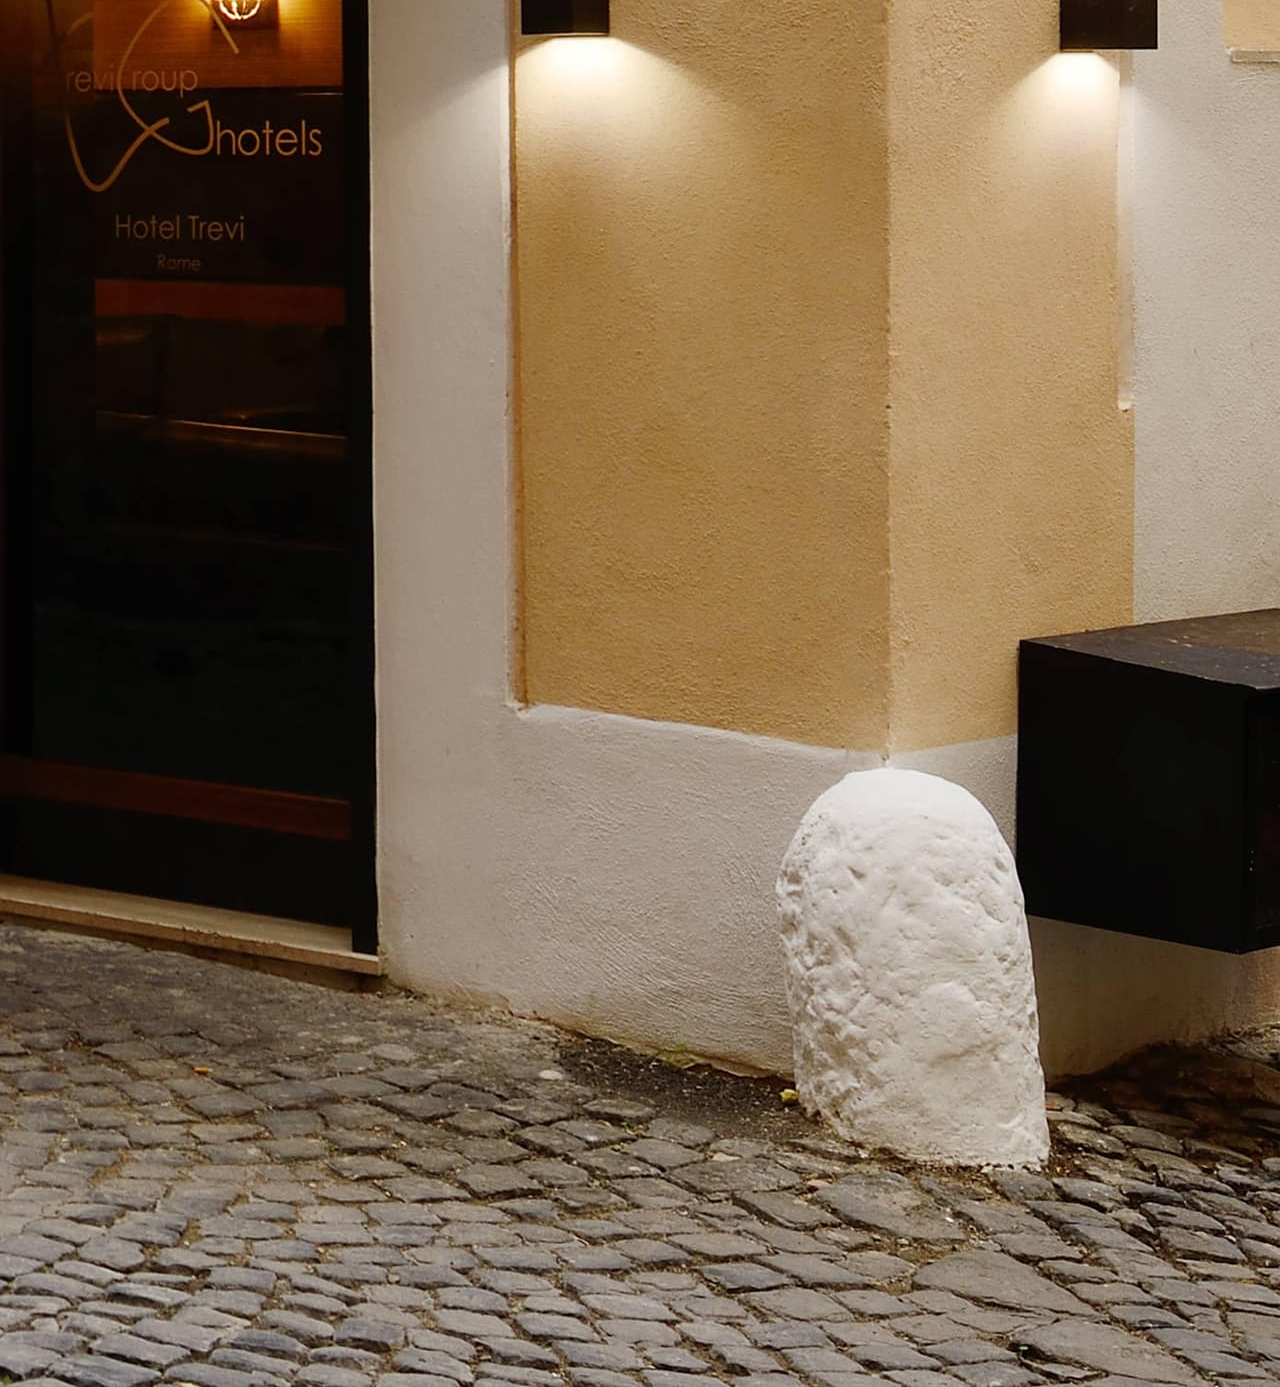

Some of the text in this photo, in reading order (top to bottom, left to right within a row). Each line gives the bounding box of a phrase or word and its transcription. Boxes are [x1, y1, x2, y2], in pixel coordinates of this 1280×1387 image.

[216, 120, 323, 156] hotels
[115, 213, 245, 242] Hotel Trevi
[156, 253, 202, 272] Rome
